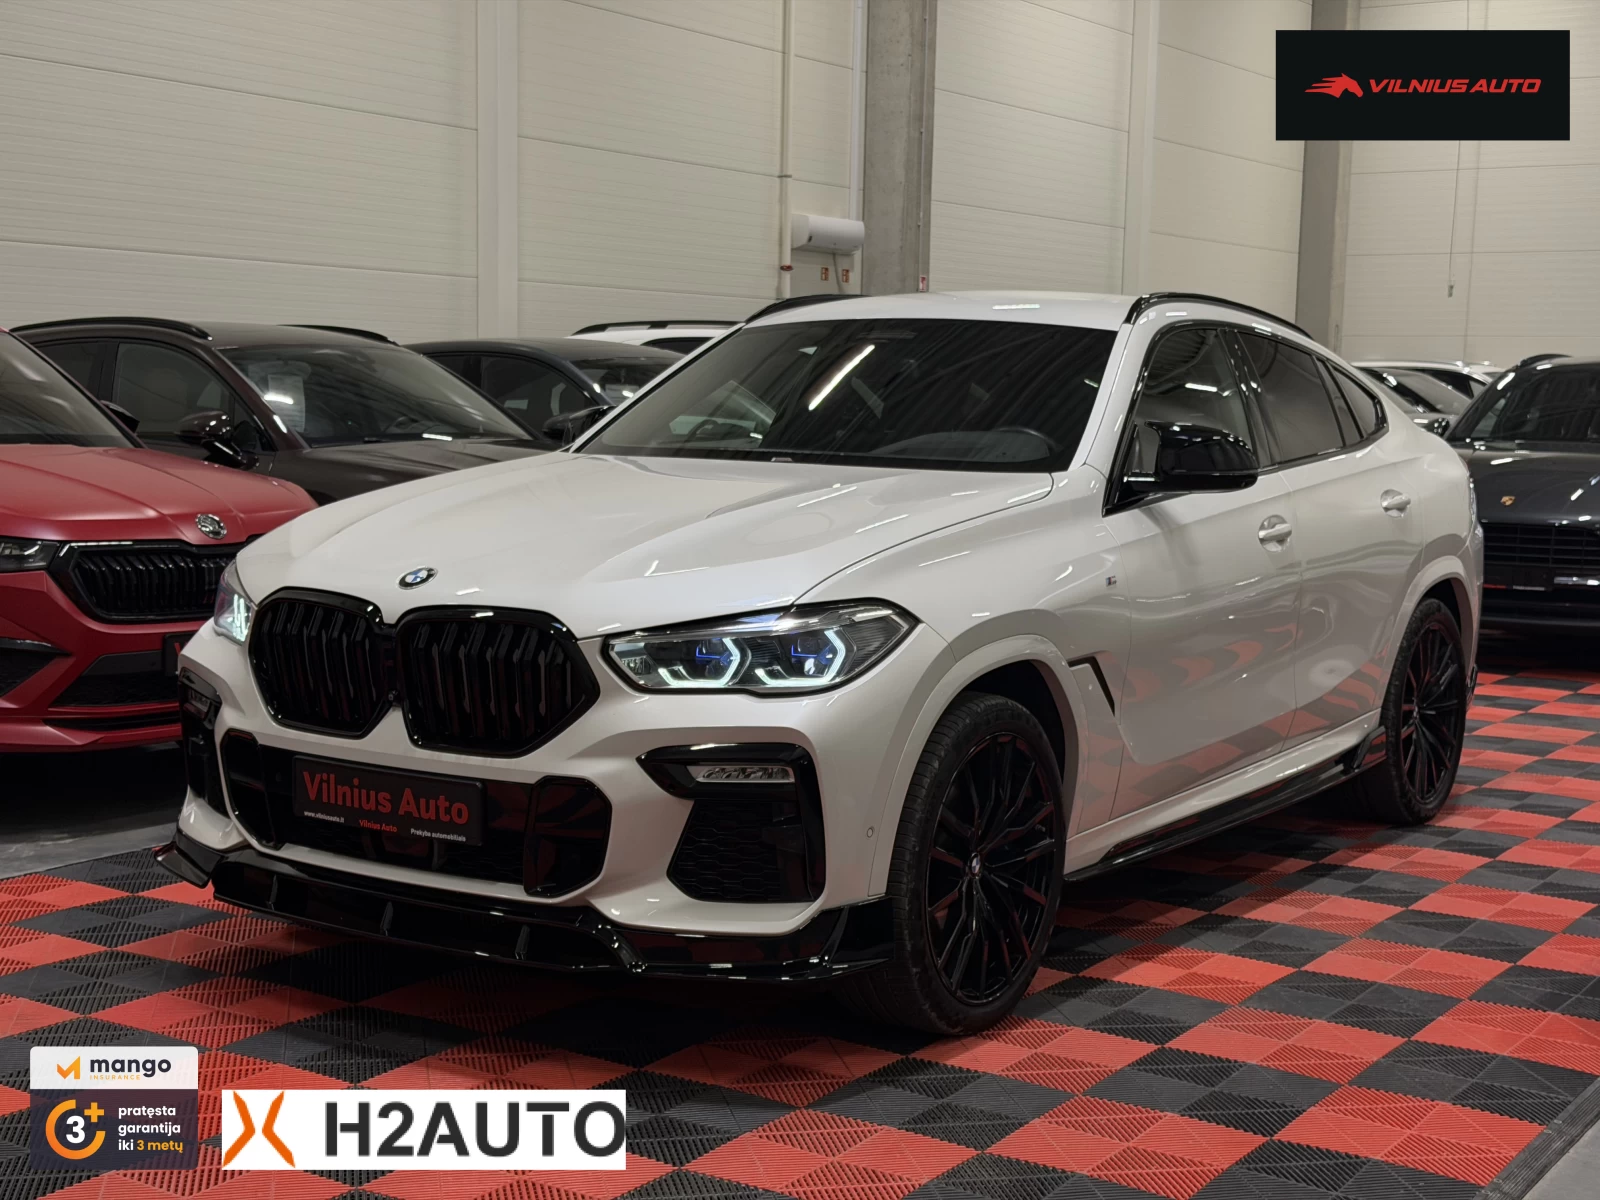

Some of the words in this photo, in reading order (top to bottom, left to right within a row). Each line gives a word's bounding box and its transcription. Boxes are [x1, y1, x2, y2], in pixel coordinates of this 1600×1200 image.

[303, 771, 393, 813] Vilnius
[398, 787, 469, 825] Auto
[359, 819, 381, 830] Vilnius
[381, 822, 398, 833] Auto
[410, 828, 431, 838] Prekyba
